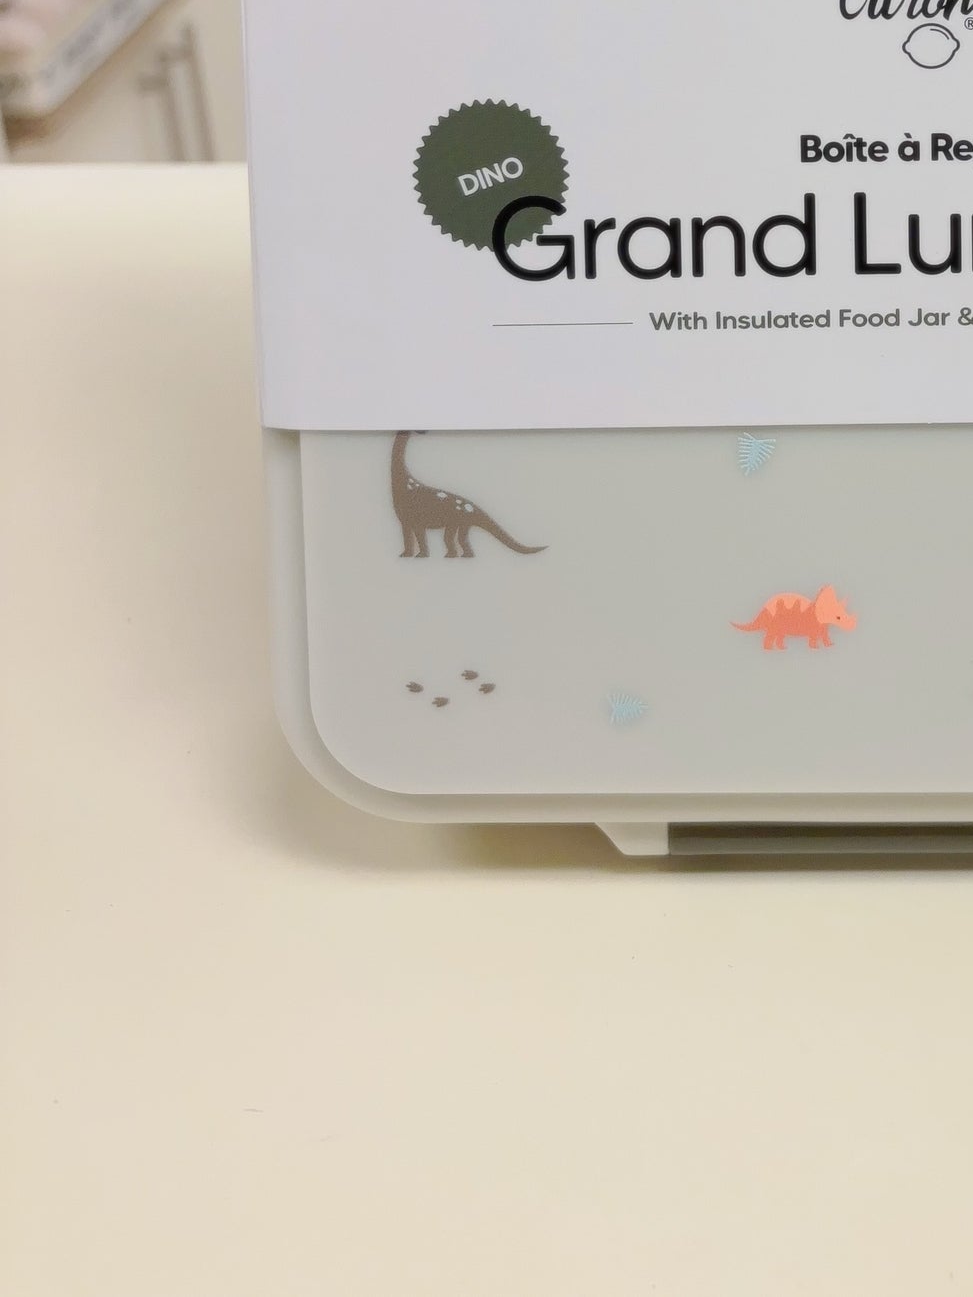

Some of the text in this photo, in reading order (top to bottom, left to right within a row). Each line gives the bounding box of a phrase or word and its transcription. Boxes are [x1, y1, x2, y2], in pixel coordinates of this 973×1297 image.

[800, 133, 890, 163] Boîte
[897, 132, 921, 162] à
[457, 157, 525, 196] DINO
[492, 192, 818, 281] Grand
[648, 311, 708, 331] With
[715, 309, 831, 330] Insulated
[839, 308, 901, 328] Food
[907, 307, 951, 327] Jar
